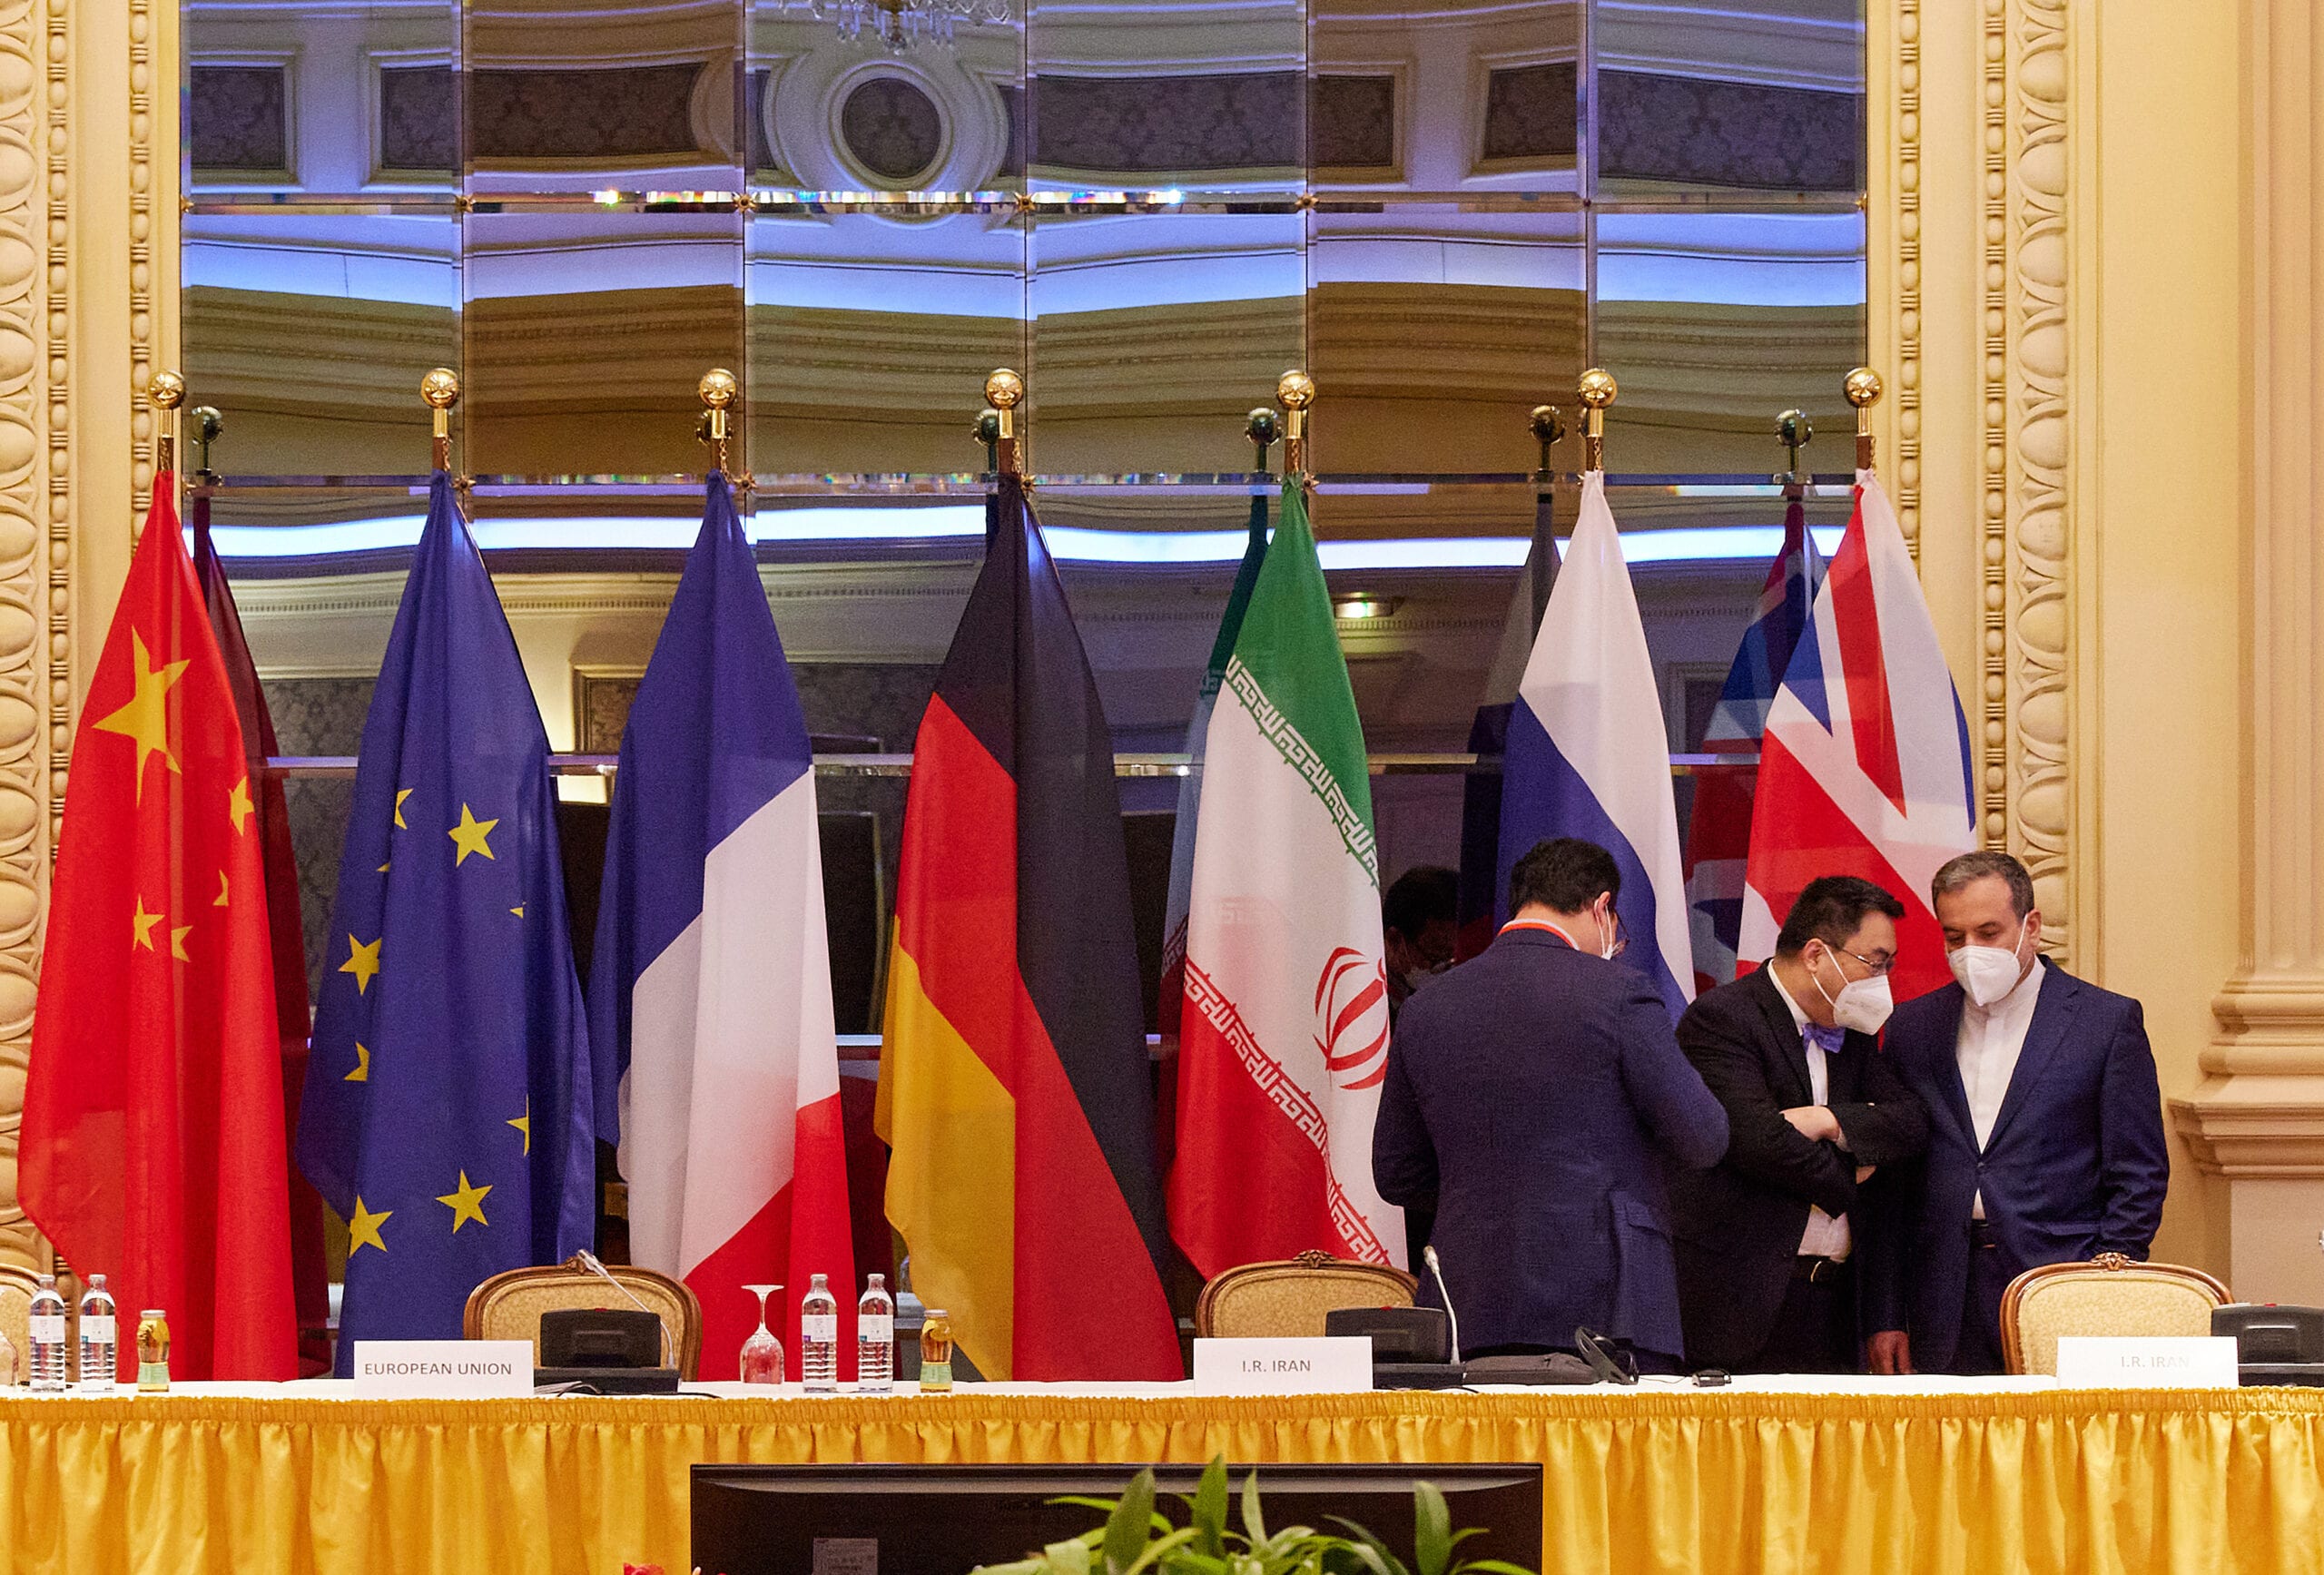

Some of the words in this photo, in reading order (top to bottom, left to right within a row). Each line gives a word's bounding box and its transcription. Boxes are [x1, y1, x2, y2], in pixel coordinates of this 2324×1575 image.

[1242, 1361, 1267, 1373] I.R.
[1272, 1360, 1311, 1373] IRAN
[2121, 1356, 2146, 1368] I.R.
[2151, 1356, 2190, 1368] IRAN
[365, 1363, 452, 1375] EUROPEAN
[458, 1363, 512, 1375] UNION
